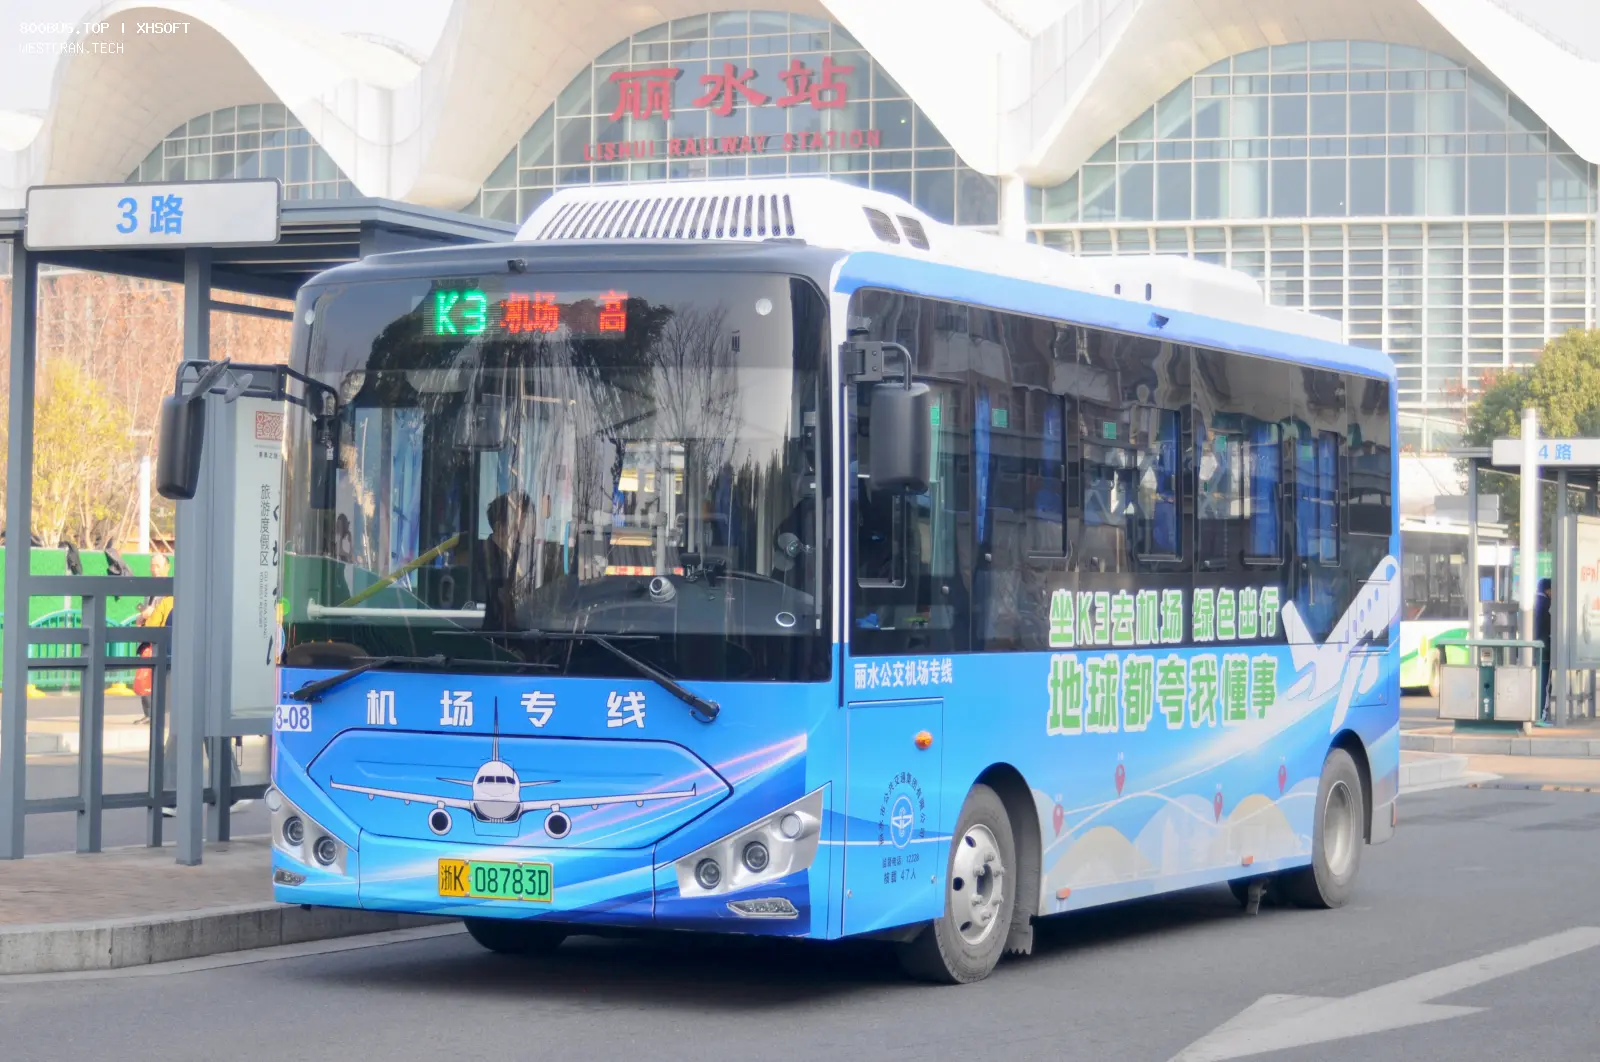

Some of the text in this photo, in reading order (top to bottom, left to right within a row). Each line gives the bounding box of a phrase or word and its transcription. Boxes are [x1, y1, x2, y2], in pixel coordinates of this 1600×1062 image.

[609, 56, 855, 121] 丽水站
[584, 129, 882, 161] LISHUI RAILWAY STATION
[434, 290, 487, 335] K3
[260, 484, 270, 566] 旅游度假区
[1049, 586, 1280, 648] 坐K3去机场 绿色出行
[854, 657, 953, 689] 丽水公交机场专线
[1047, 653, 1278, 736] 地球都夸我懂事
